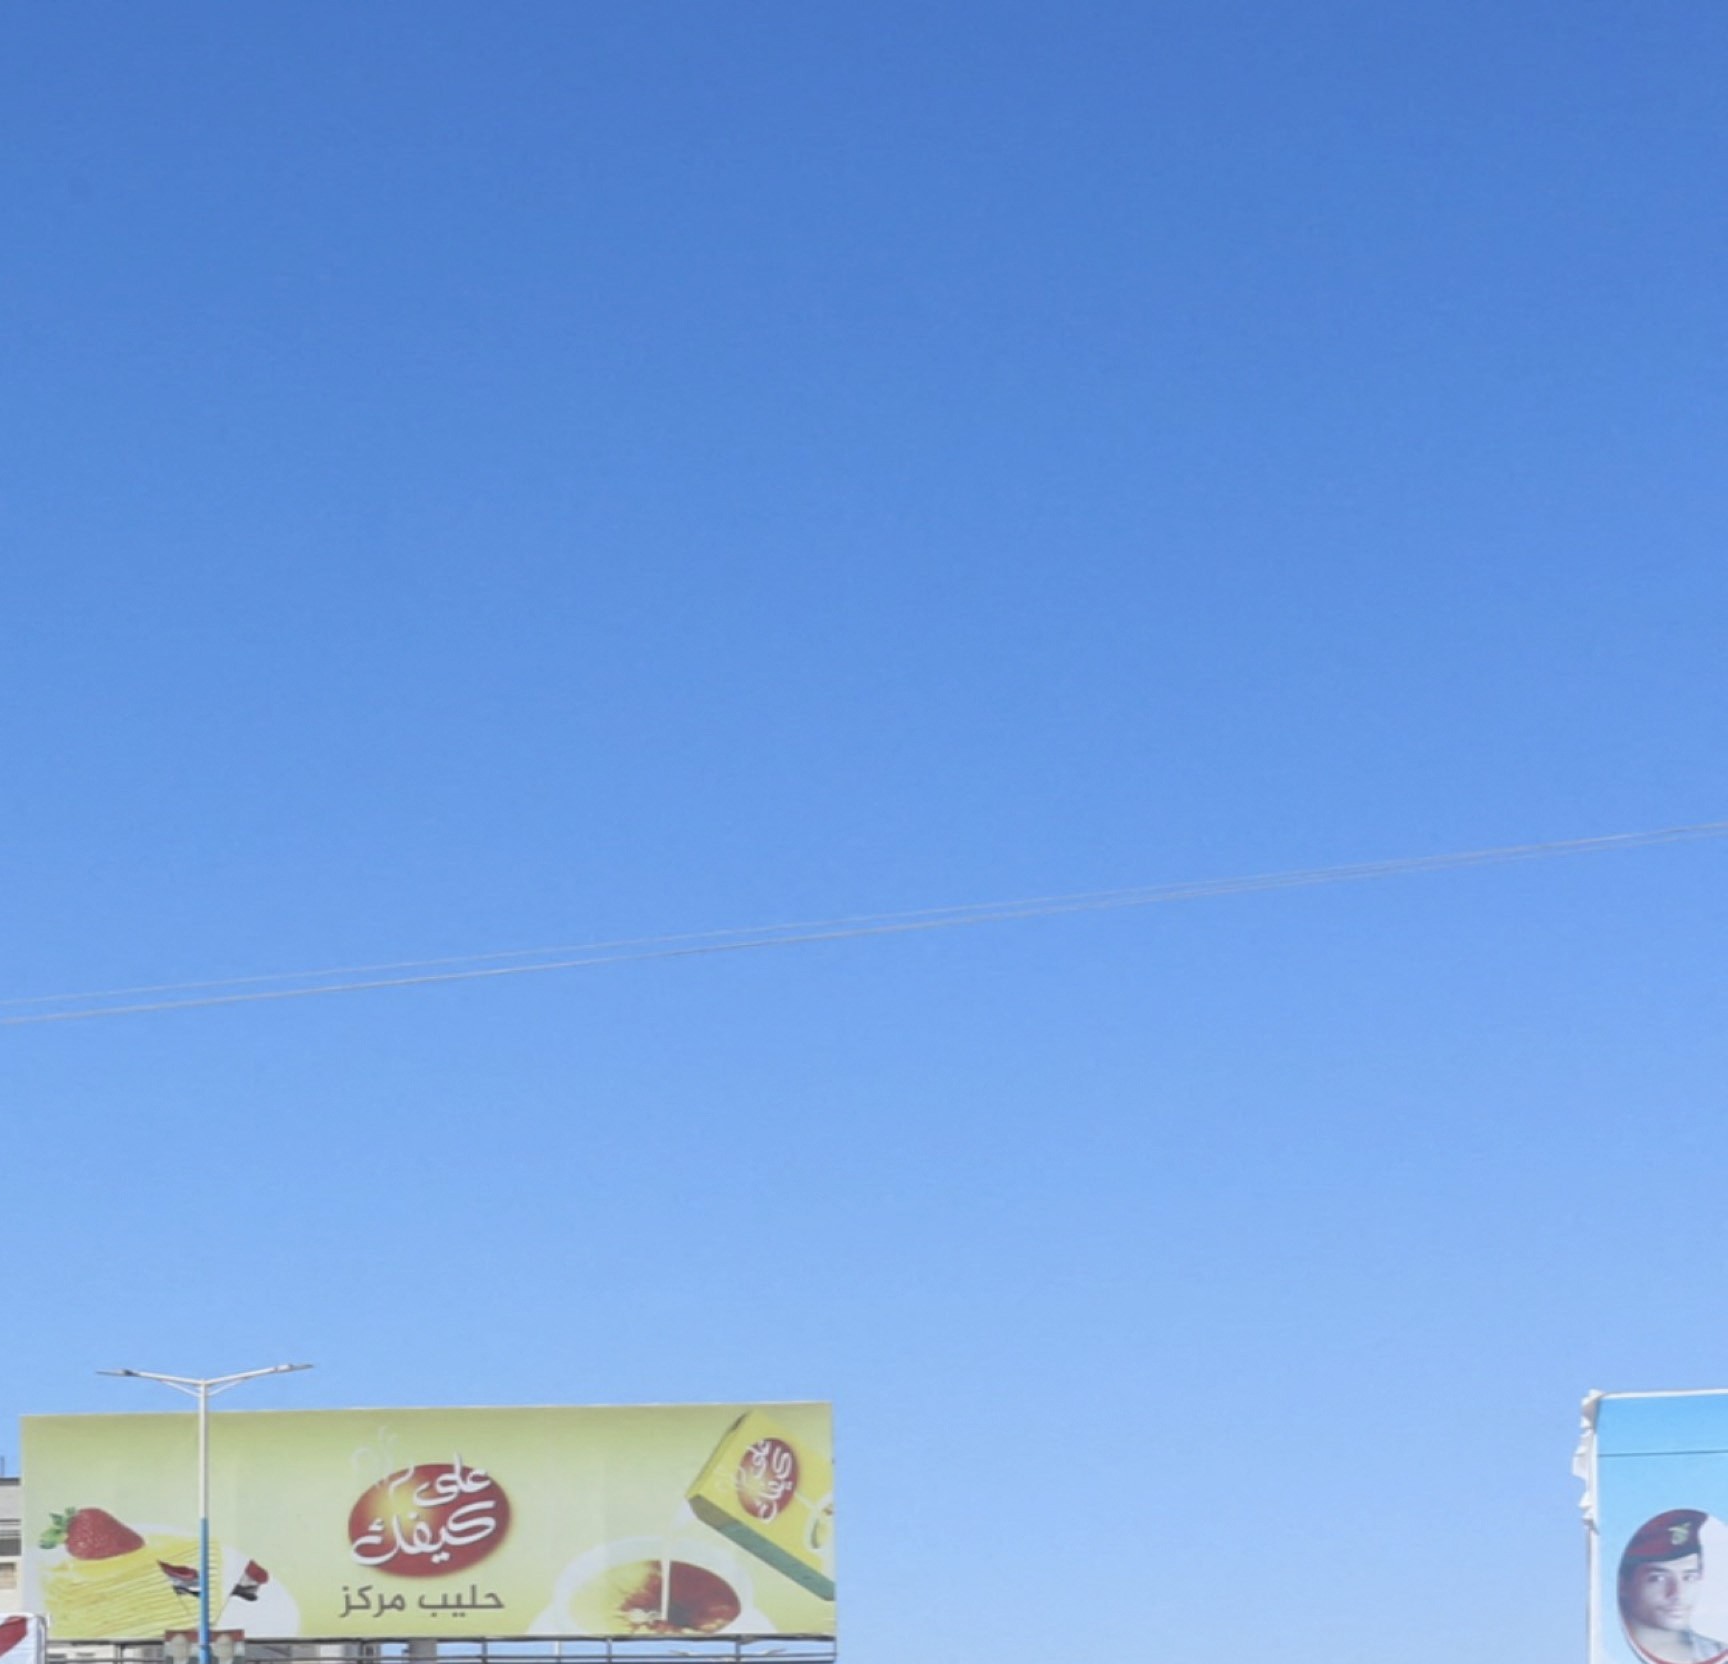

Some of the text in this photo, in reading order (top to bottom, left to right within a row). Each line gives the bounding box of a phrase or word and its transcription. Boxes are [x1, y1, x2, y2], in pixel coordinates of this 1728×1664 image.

[413, 1450, 493, 1507] على
[352, 1499, 497, 1566] كيفك
[339, 1584, 505, 1618] حليب مركز
